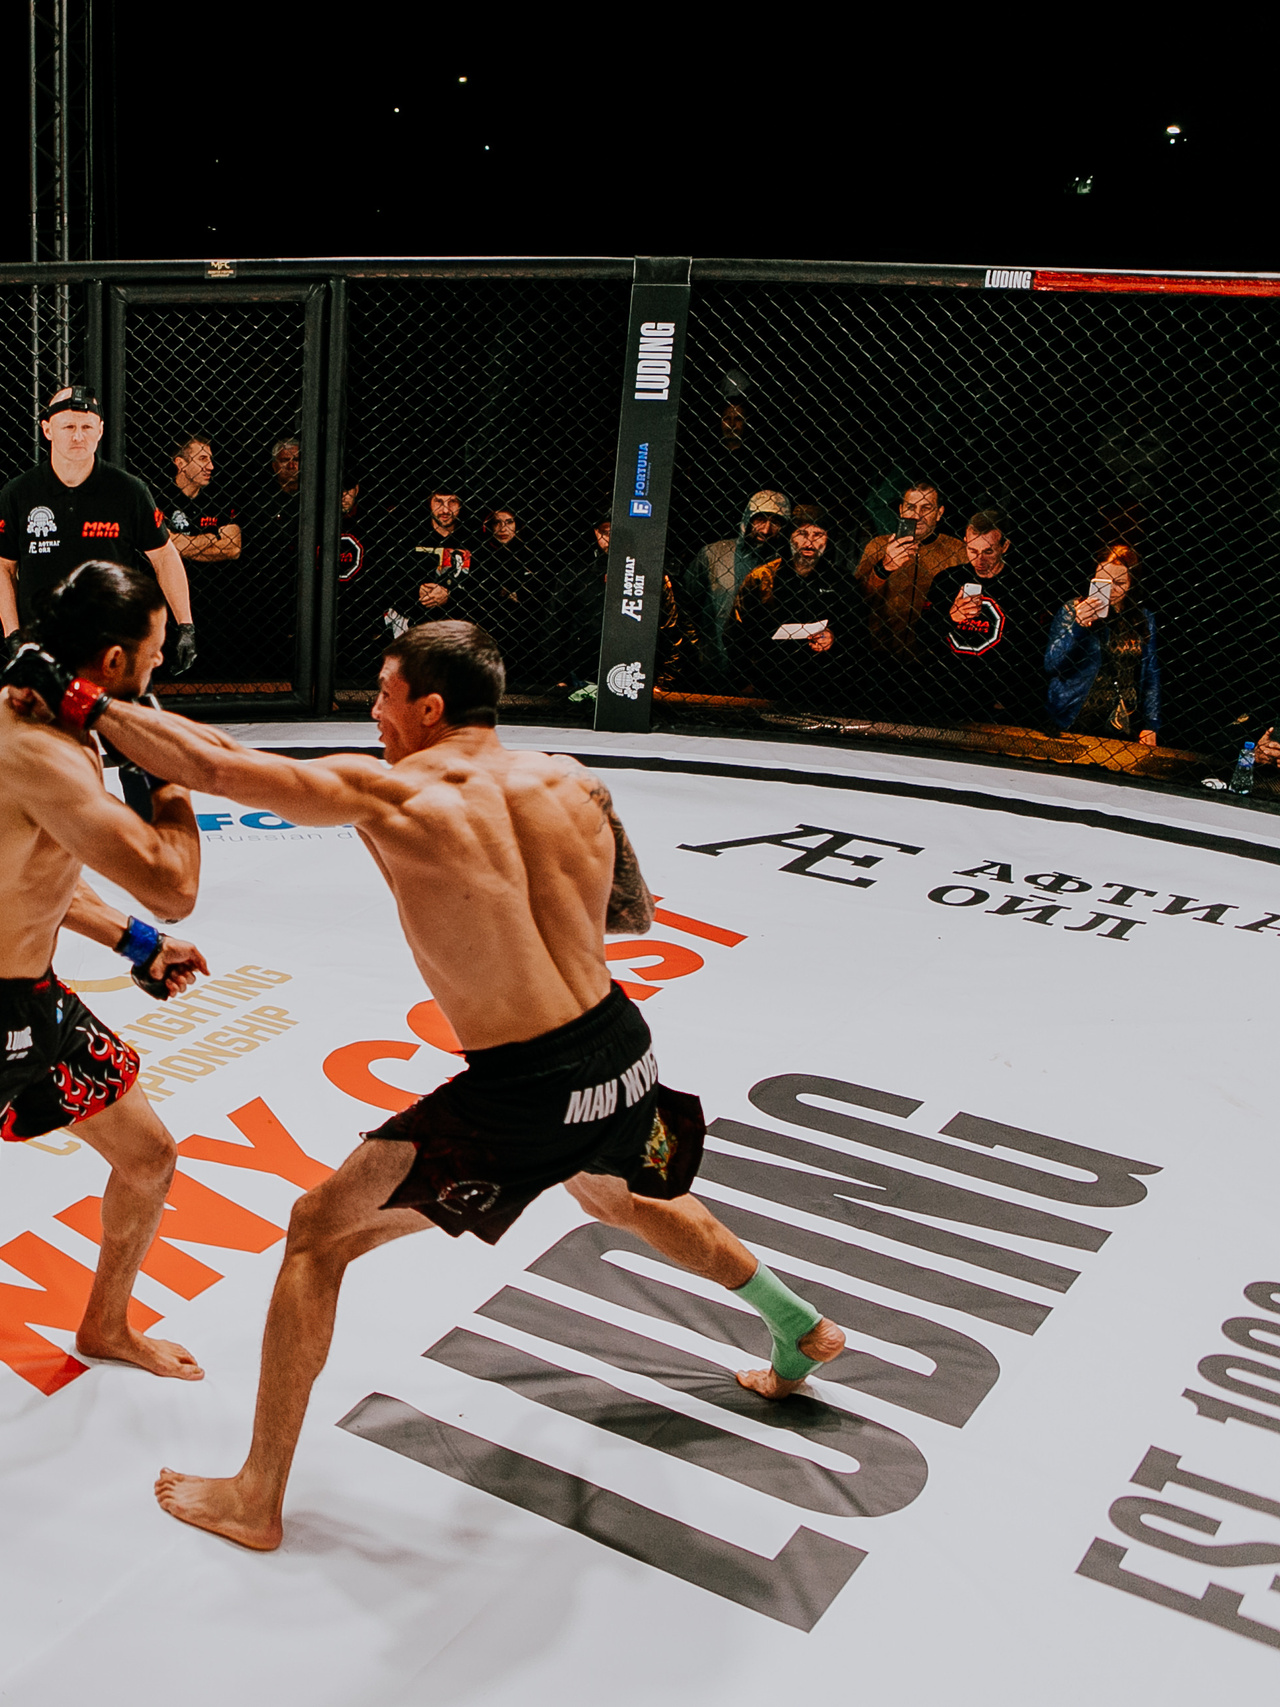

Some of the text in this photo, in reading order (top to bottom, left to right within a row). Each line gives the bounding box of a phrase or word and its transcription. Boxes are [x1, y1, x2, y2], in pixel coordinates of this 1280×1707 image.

[984, 269, 1032, 289] LUDING
[634, 321, 676, 401] LUDING
[634, 442, 649, 497] FORTUNA
[83, 521, 120, 531] MMA
[206, 832, 322, 843] Russian
[927, 884, 1147, 941] ОЙЛ
[334, 1072, 1165, 1634] LUDING
